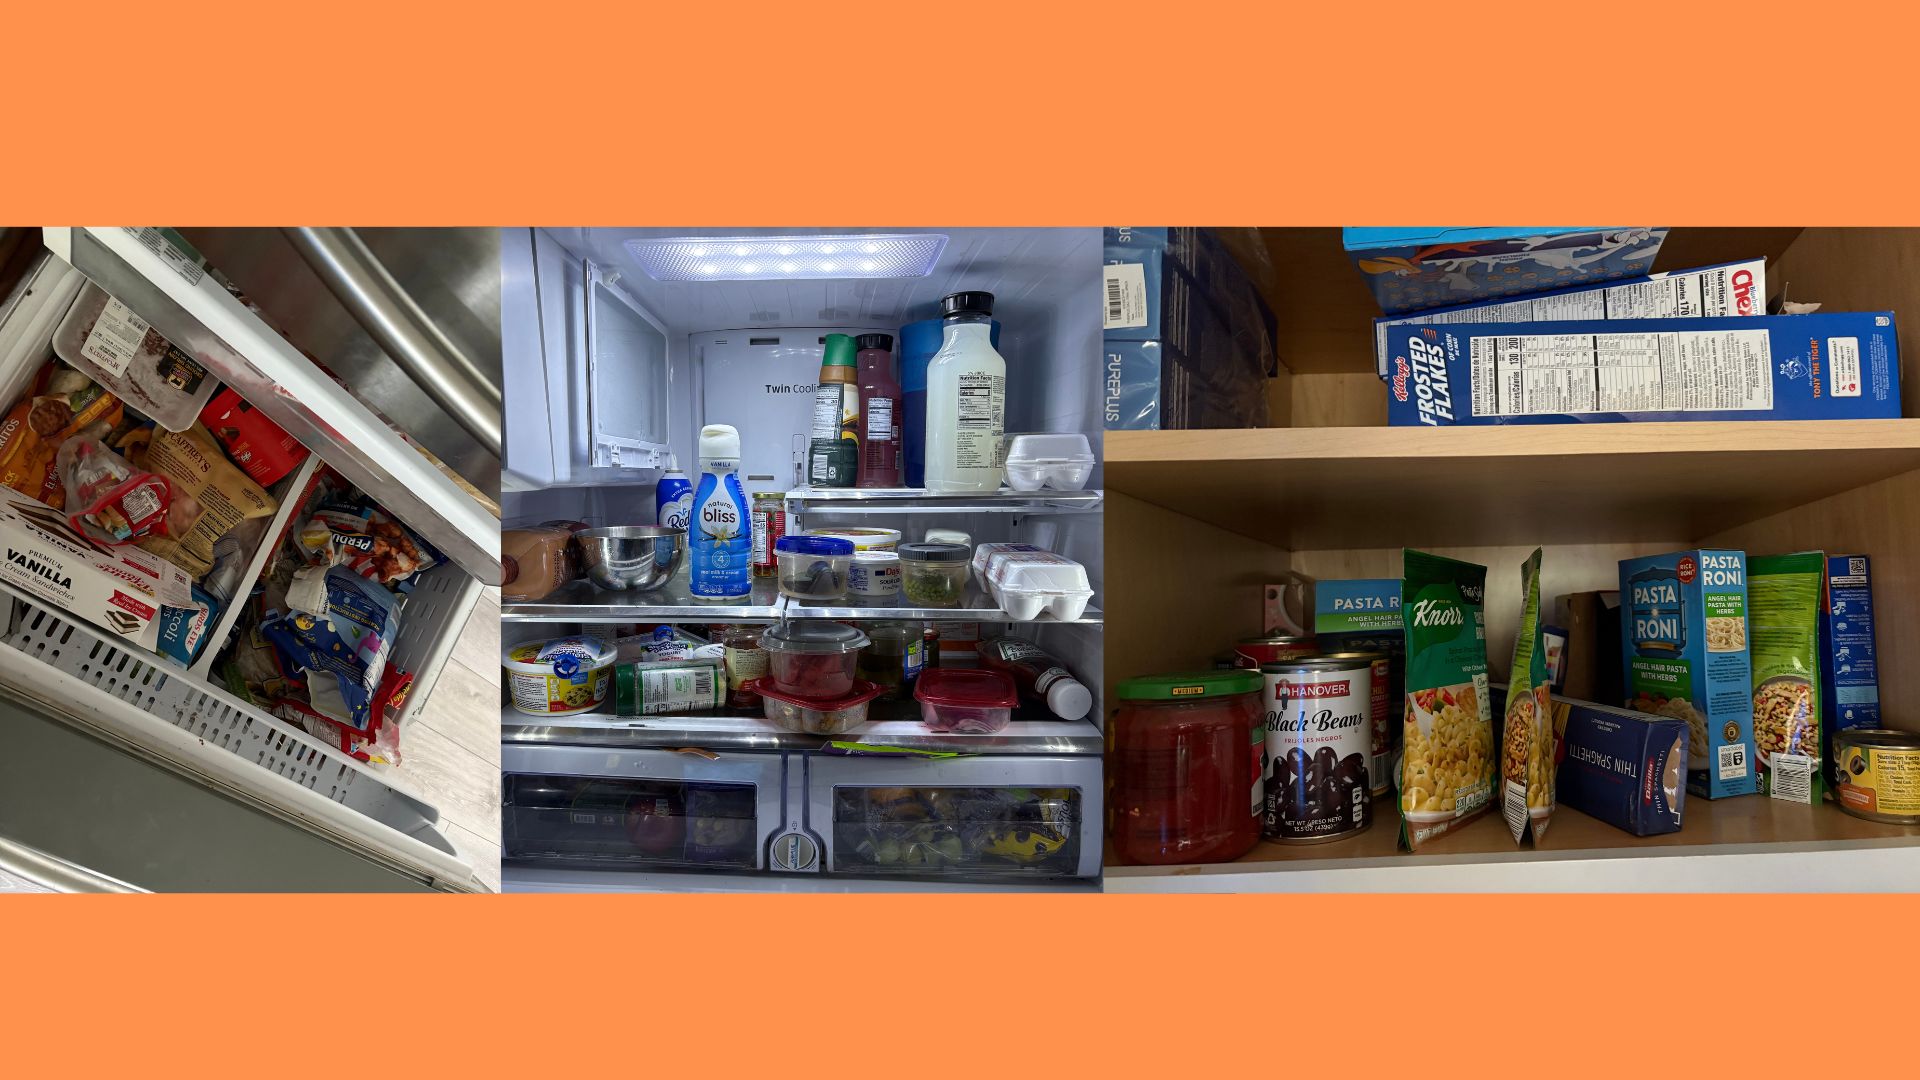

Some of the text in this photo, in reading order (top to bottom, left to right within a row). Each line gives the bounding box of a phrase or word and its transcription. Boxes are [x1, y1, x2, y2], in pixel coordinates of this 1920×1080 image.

[1717, 270, 1727, 304] Nutrition
[1680, 301, 1690, 316] 170
[1445, 333, 1457, 361] OF CORN
[1508, 337, 1519, 350] 200
[1810, 339, 1819, 360] TIGER
[1509, 353, 1519, 365] 130
[1812, 362, 1820, 376] THE
[1105, 353, 1122, 422] PUREPLUS
[1392, 355, 1411, 402] Kellogg's
[1408, 336, 1438, 426] FROSTED
[1427, 344, 1454, 421] FLAKES
[765, 384, 791, 394] Twin
[1473, 394, 1481, 415] Nutrition
[707, 500, 733, 509] natural
[667, 510, 690, 529] Red
[703, 508, 736, 523] bliss
[7, 547, 72, 590] VANILLA
[28, 549, 64, 571] PREMIUM
[1702, 555, 1741, 569] PASTA
[4, 562, 31, 579] Cream
[32, 575, 76, 601] Sandwiches
[1703, 571, 1742, 586] RONI
[1334, 598, 1384, 610] PASTA
[1633, 585, 1677, 605] PASTA
[1347, 615, 1372, 623] ANGEL
[1413, 598, 1464, 628] Knorr
[186, 606, 208, 648] BIRDS EYE
[1636, 618, 1678, 640] RONI
[1632, 662, 1688, 674] ANGEL HAIR PASTA
[1640, 672, 1678, 682] WITH HERBS
[1290, 685, 1344, 697] HANOVER
[1265, 709, 1364, 732] Black Beans
[1284, 735, 1343, 745] FRIJOLES NEGROS
[1569, 743, 1637, 778] THIN SPAGHETTI
[1876, 753, 1904, 761] Nutrition
[1645, 761, 1654, 801] Barilla
[1653, 750, 1666, 815] THIN SPAGHETTI
[1285, 819, 1296, 827] NET
[1327, 815, 1343, 823] NETO
